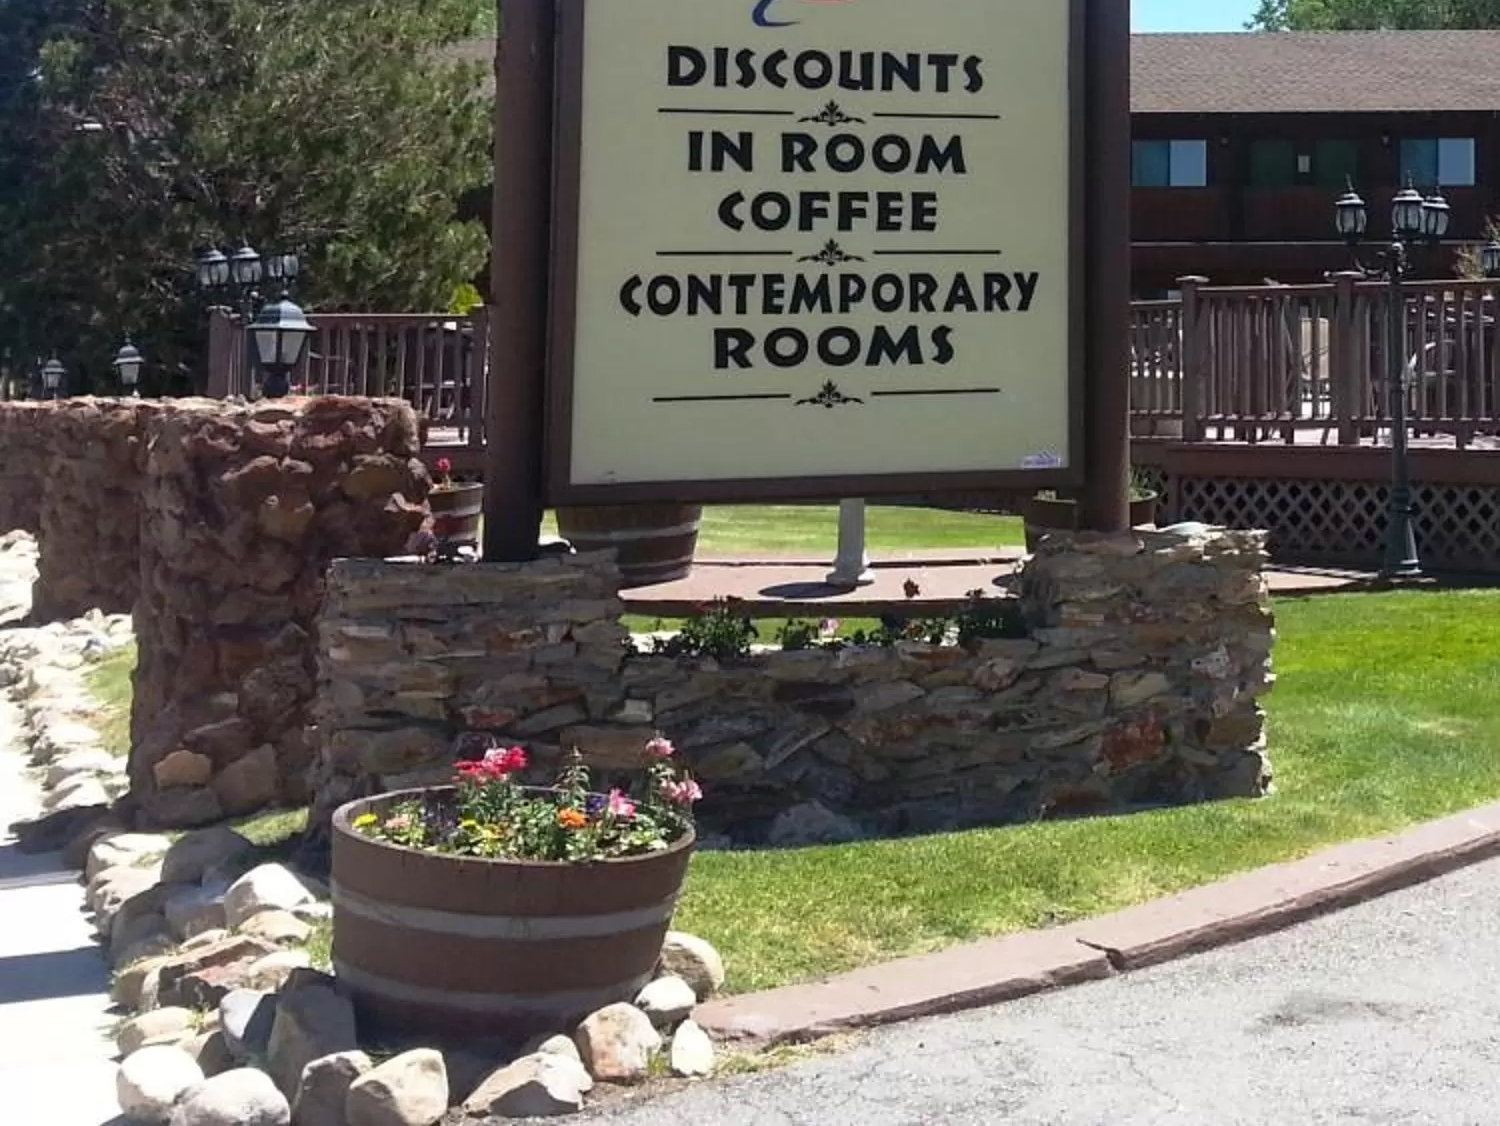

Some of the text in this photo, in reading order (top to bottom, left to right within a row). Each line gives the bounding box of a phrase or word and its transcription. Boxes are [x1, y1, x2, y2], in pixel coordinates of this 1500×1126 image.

[667, 46, 983, 93] DISCOUNTS
[688, 130, 966, 174] IN ROOM
[718, 190, 937, 232] COFFEE
[620, 272, 1039, 317] CONTEMPORARY
[714, 324, 954, 369] ROOMS
